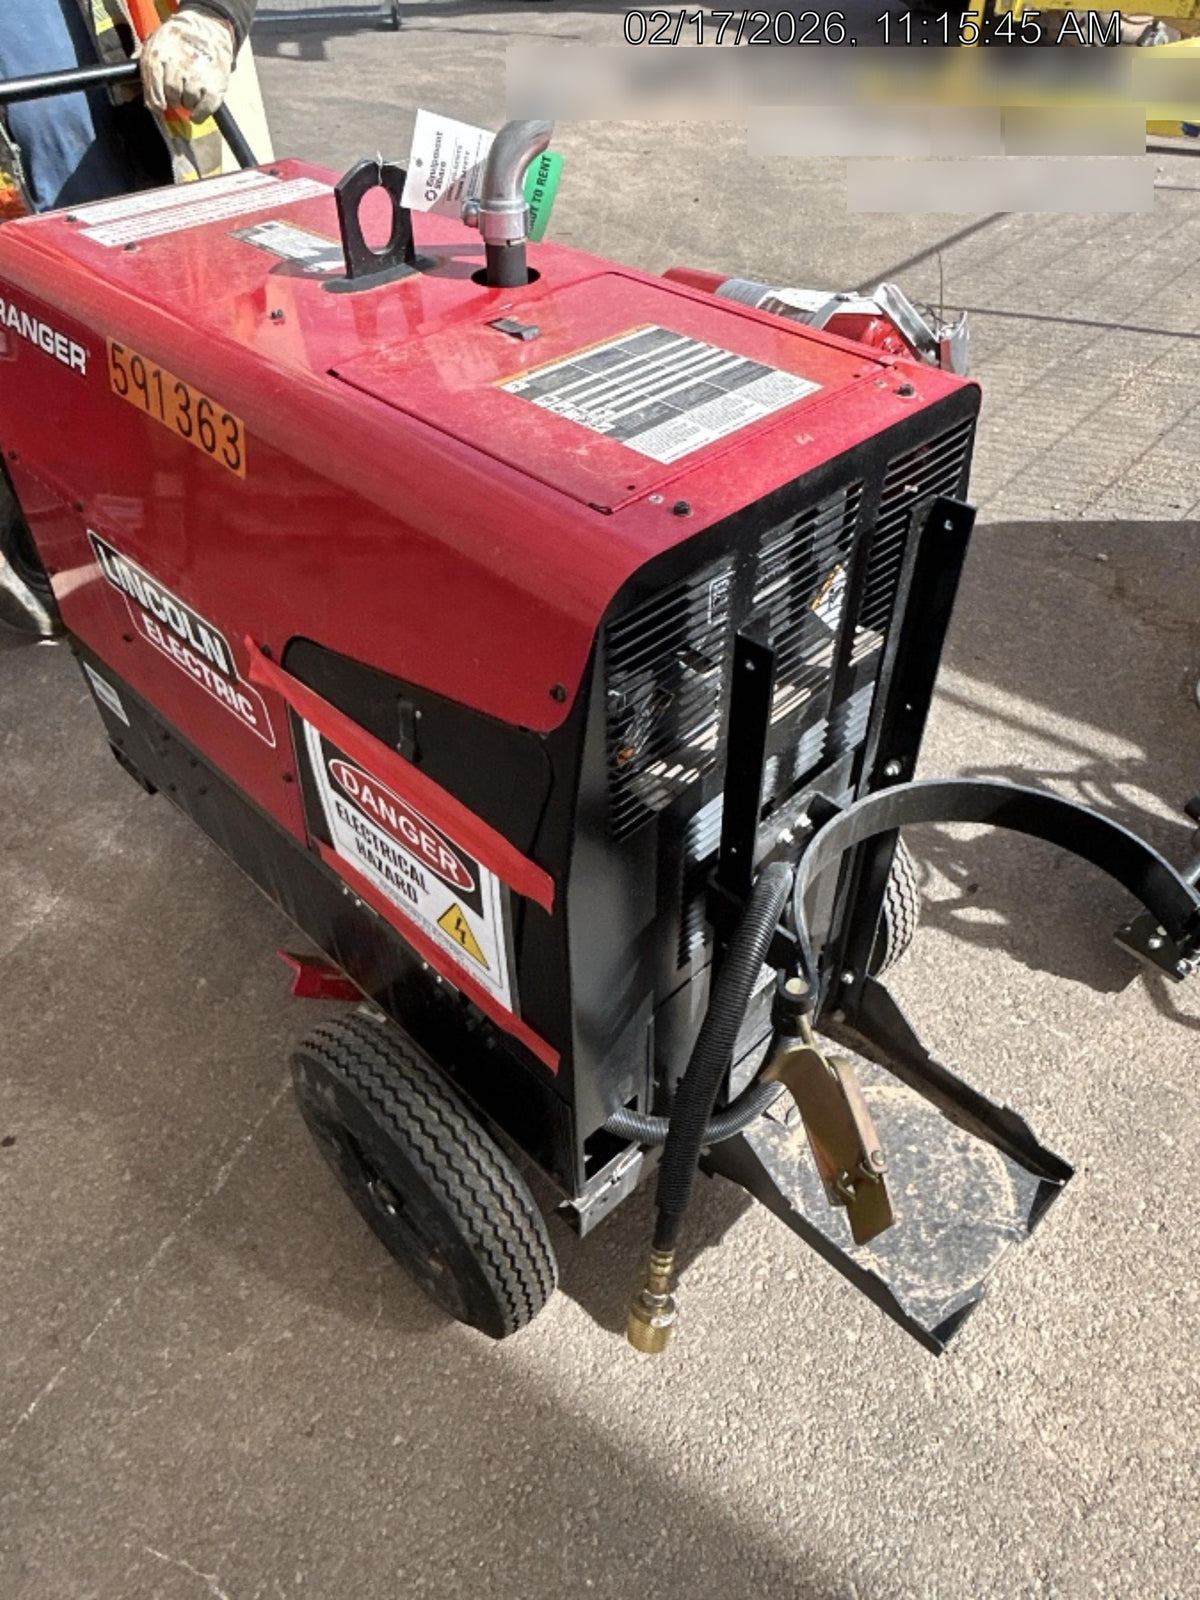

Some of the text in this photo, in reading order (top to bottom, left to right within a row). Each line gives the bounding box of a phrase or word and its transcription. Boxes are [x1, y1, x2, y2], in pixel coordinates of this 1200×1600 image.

[536, 155, 551, 187] RENT
[111, 343, 241, 469] 591363
[97, 543, 230, 674] LINCOLN
[142, 613, 257, 724] ELECTRIC
[335, 801, 430, 895] ELECTRICAL
[340, 765, 459, 881] DANGER
[355, 837, 418, 904] HAZARD
